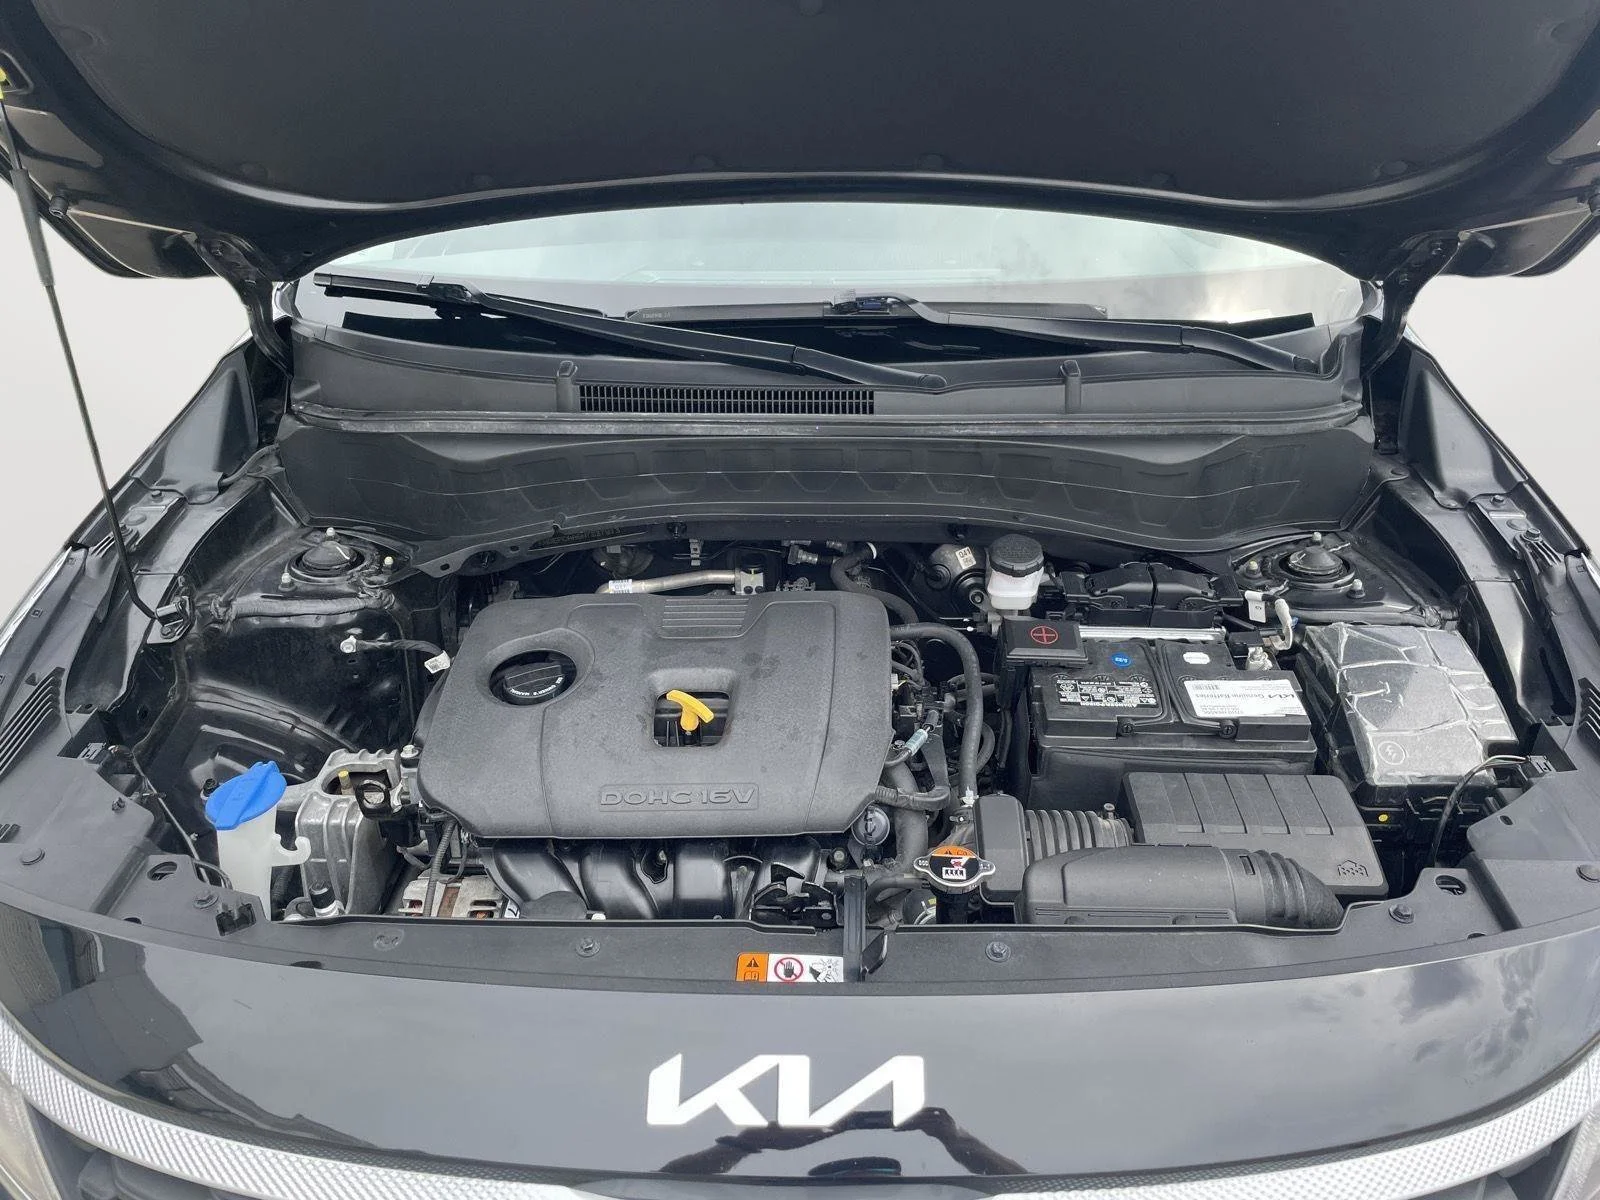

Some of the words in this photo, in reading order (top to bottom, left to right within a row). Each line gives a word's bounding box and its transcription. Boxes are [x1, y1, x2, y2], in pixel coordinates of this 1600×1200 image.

[600, 787, 693, 806] DOHC
[700, 786, 756, 805] 16V
[646, 1053, 926, 1128] KIA
